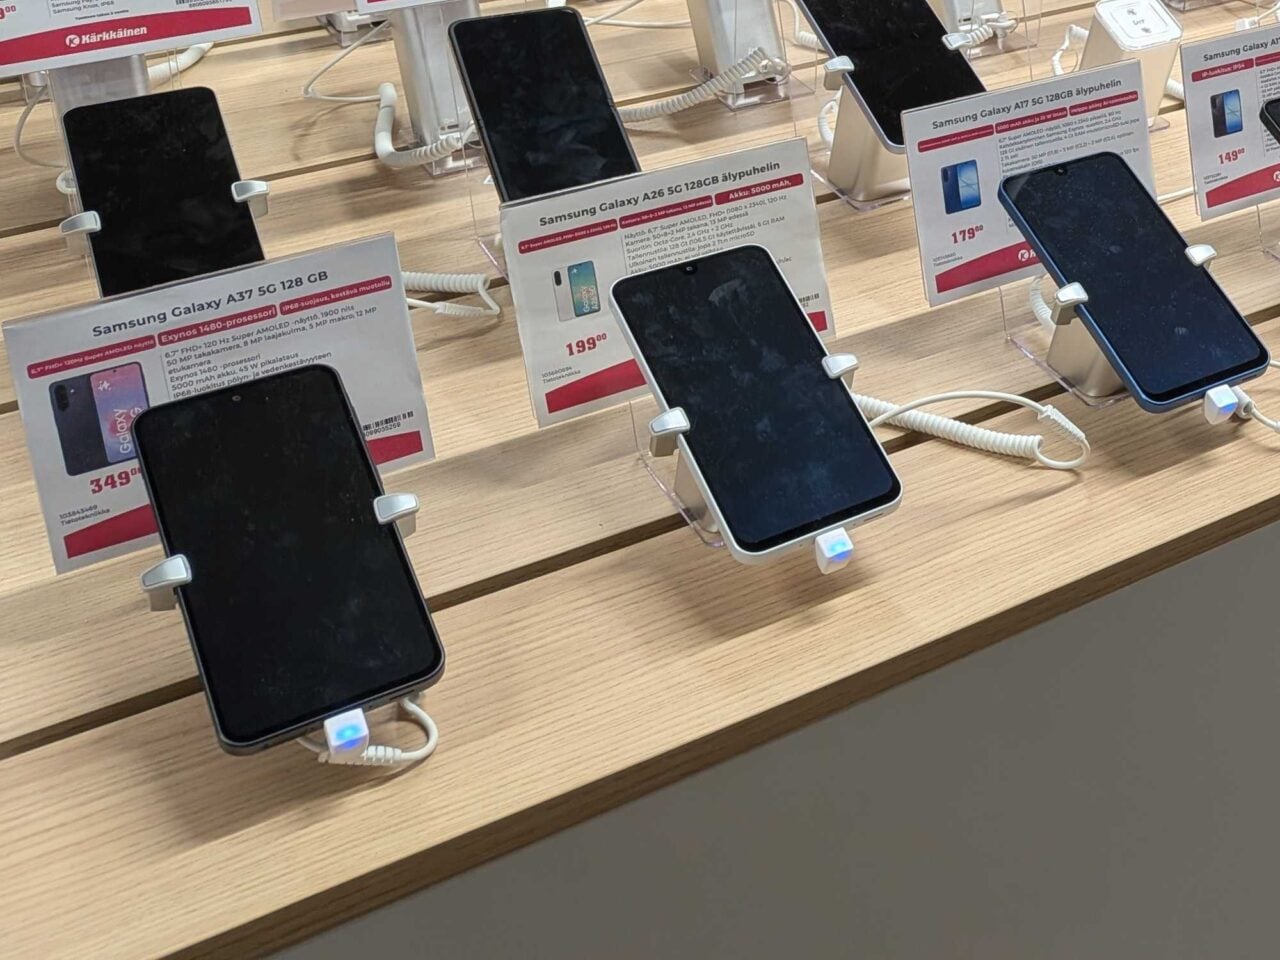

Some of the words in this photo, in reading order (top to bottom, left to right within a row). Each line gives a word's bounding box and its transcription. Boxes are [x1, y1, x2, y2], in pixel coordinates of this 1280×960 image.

[52, 5, 81, 14] Samsung
[81, 26, 147, 44] Kärkkäinen
[1203, 47, 1241, 61] Samsung
[1242, 41, 1268, 52] Galaxy
[931, 112, 978, 129] Samsung
[979, 104, 1012, 118] Galaxy
[1013, 99, 1029, 110] A17
[1031, 96, 1043, 106] 5G
[1045, 89, 1073, 102] 128GB
[1075, 79, 1121, 96] älypuhelin
[539, 206, 596, 226] Samsung
[598, 195, 639, 211] Galaxy
[641, 188, 664, 201] A26
[666, 184, 682, 195] 5G
[684, 175, 719, 190] 128GB
[721, 161, 780, 182] älypuhelin
[728, 190, 748, 199] Akku:
[750, 183, 770, 194] 5000
[771, 179, 791, 189] mAh,
[659, 221, 678, 231] Super
[358, 280, 390, 292] muotoilu
[92, 312, 167, 337] Samsung
[174, 298, 221, 317] Galaxy
[226, 288, 253, 304] A37
[257, 283, 277, 296] 5G
[279, 276, 303, 290] 128
[306, 270, 328, 283] GB
[161, 328, 197, 342] Exynos
[198, 307, 275, 332] 1480-prosessori
[203, 339, 218, 348] 120
[230, 330, 254, 342] Super
[255, 320, 290, 335] AMOLED
[320, 308, 339, 318] 1900
[340, 304, 354, 313] nits
[103, 344, 133, 356] AMOLED
[193, 343, 242, 359] takakamera,
[263, 325, 307, 341] laajakulma,
[167, 359, 211, 374] etukamera
[169, 370, 198, 383] Exynos
[199, 364, 218, 375] 1480
[219, 352, 261, 370] -prosessori
[171, 379, 194, 391] 5000
[195, 374, 215, 384] mAh
[216, 369, 237, 379] akku,
[259, 352, 298, 368] pikalataus
[172, 380, 225, 399] IP68-luokitus
[260, 351, 331, 375] vedenkestävyyteen
[119, 408, 133, 454] Galaxy
